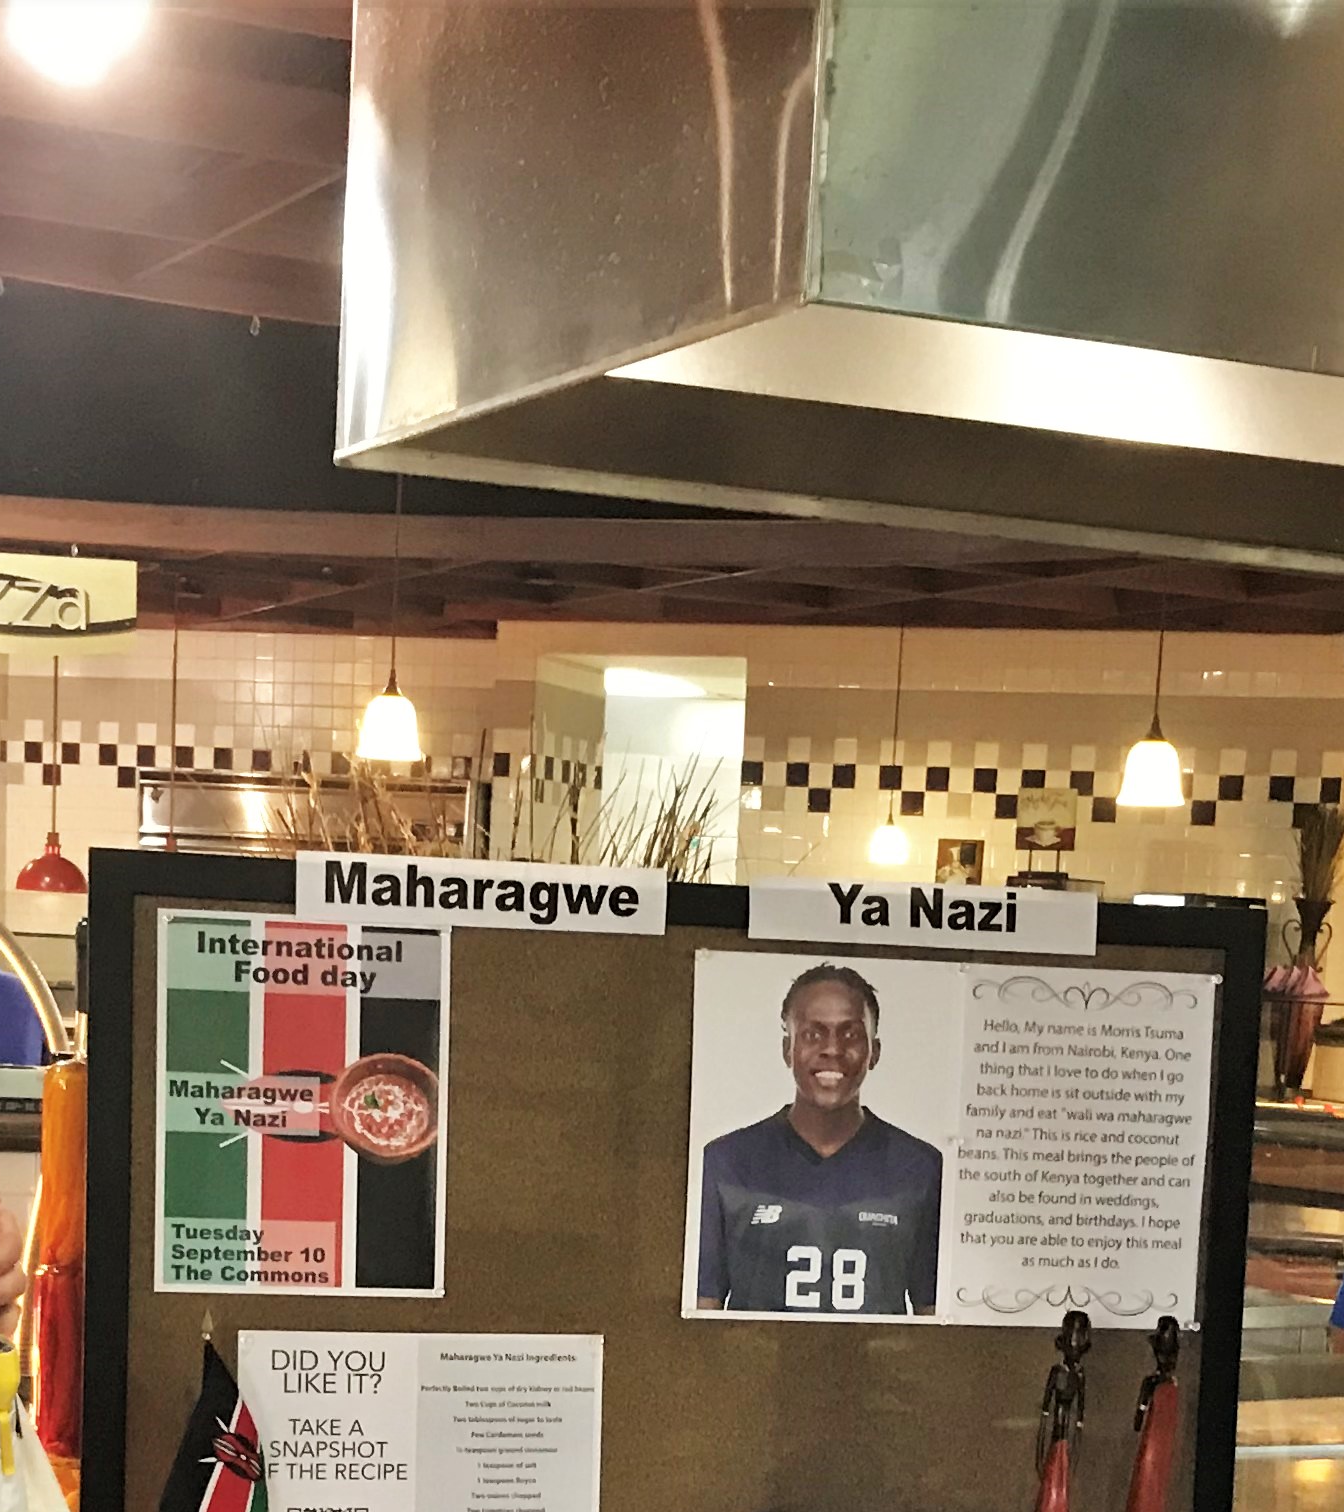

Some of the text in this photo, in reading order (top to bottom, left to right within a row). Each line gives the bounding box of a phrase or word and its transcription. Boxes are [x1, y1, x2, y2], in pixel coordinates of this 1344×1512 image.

[325, 860, 640, 923] Maharagwe
[829, 883, 1017, 932] Ya Nazi
[197, 931, 402, 963] International
[234, 961, 377, 994] Food day
[983, 1019, 1183, 1040] Hello, My name is Morris Tsuma
[974, 1041, 999, 1053] and
[1002, 1042, 1006, 1053] I
[1009, 1044, 1029, 1054] am
[1033, 1043, 1063, 1055] from
[1068, 1044, 1116, 1059] Nairobi,
[1165, 1050, 1191, 1062] One
[980, 1063, 1014, 1079] thing
[1019, 1064, 1043, 1076] that
[1054, 1065, 1081, 1078] love
[1085, 1068, 1098, 1079] to
[1102, 1068, 1118, 1080] do
[1122, 1069, 1156, 1081] when
[1160, 1070, 1163, 1080] I
[1167, 1073, 1183, 1085] go
[169, 1080, 313, 1104] Maharagwe
[977, 1084, 1184, 1106] back home is sit outside with my
[195, 1108, 287, 1128] Ya Nazi
[966, 1104, 1006, 1120] family
[1009, 1105, 1034, 1118] and
[1038, 1107, 1057, 1120] eat
[1096, 1112, 1114, 1121] wa
[1118, 1110, 1192, 1126] maharagwe
[977, 1129, 992, 1138] na
[1033, 1128, 1057, 1141] This
[1061, 1130, 1070, 1141] is
[1075, 1130, 1097, 1142] rice
[1101, 1132, 1124, 1143] and
[1128, 1134, 1179, 1146] coconut
[958, 1146, 1195, 1168] beans. This meal brings the people of
[959, 1168, 1190, 1188] the south of Kenya together and can
[989, 1190, 1159, 1210] also be found in weddings,
[964, 1211, 1180, 1232] graduations, and birthdays. I hope
[172, 1224, 264, 1245] Tuesday
[960, 1232, 1181, 1251] that you are able to enjoy this meal
[172, 1245, 325, 1266] September 10
[1022, 1256, 1120, 1269] as much as I do.
[172, 1265, 329, 1284] The Commons
[785, 1245, 867, 1310] 28
[271, 1349, 386, 1372] DID YOU
[440, 1353, 491, 1363] Maharagwe
[494, 1353, 503, 1361] Ya
[526, 1353, 576, 1363] Ingredients
[283, 1373, 382, 1395] LIKE IT?
[288, 1419, 364, 1436] TAKE A
[269, 1441, 388, 1459] SNAPSHOT
[268, 1463, 408, 1481] F THE RECIPE
